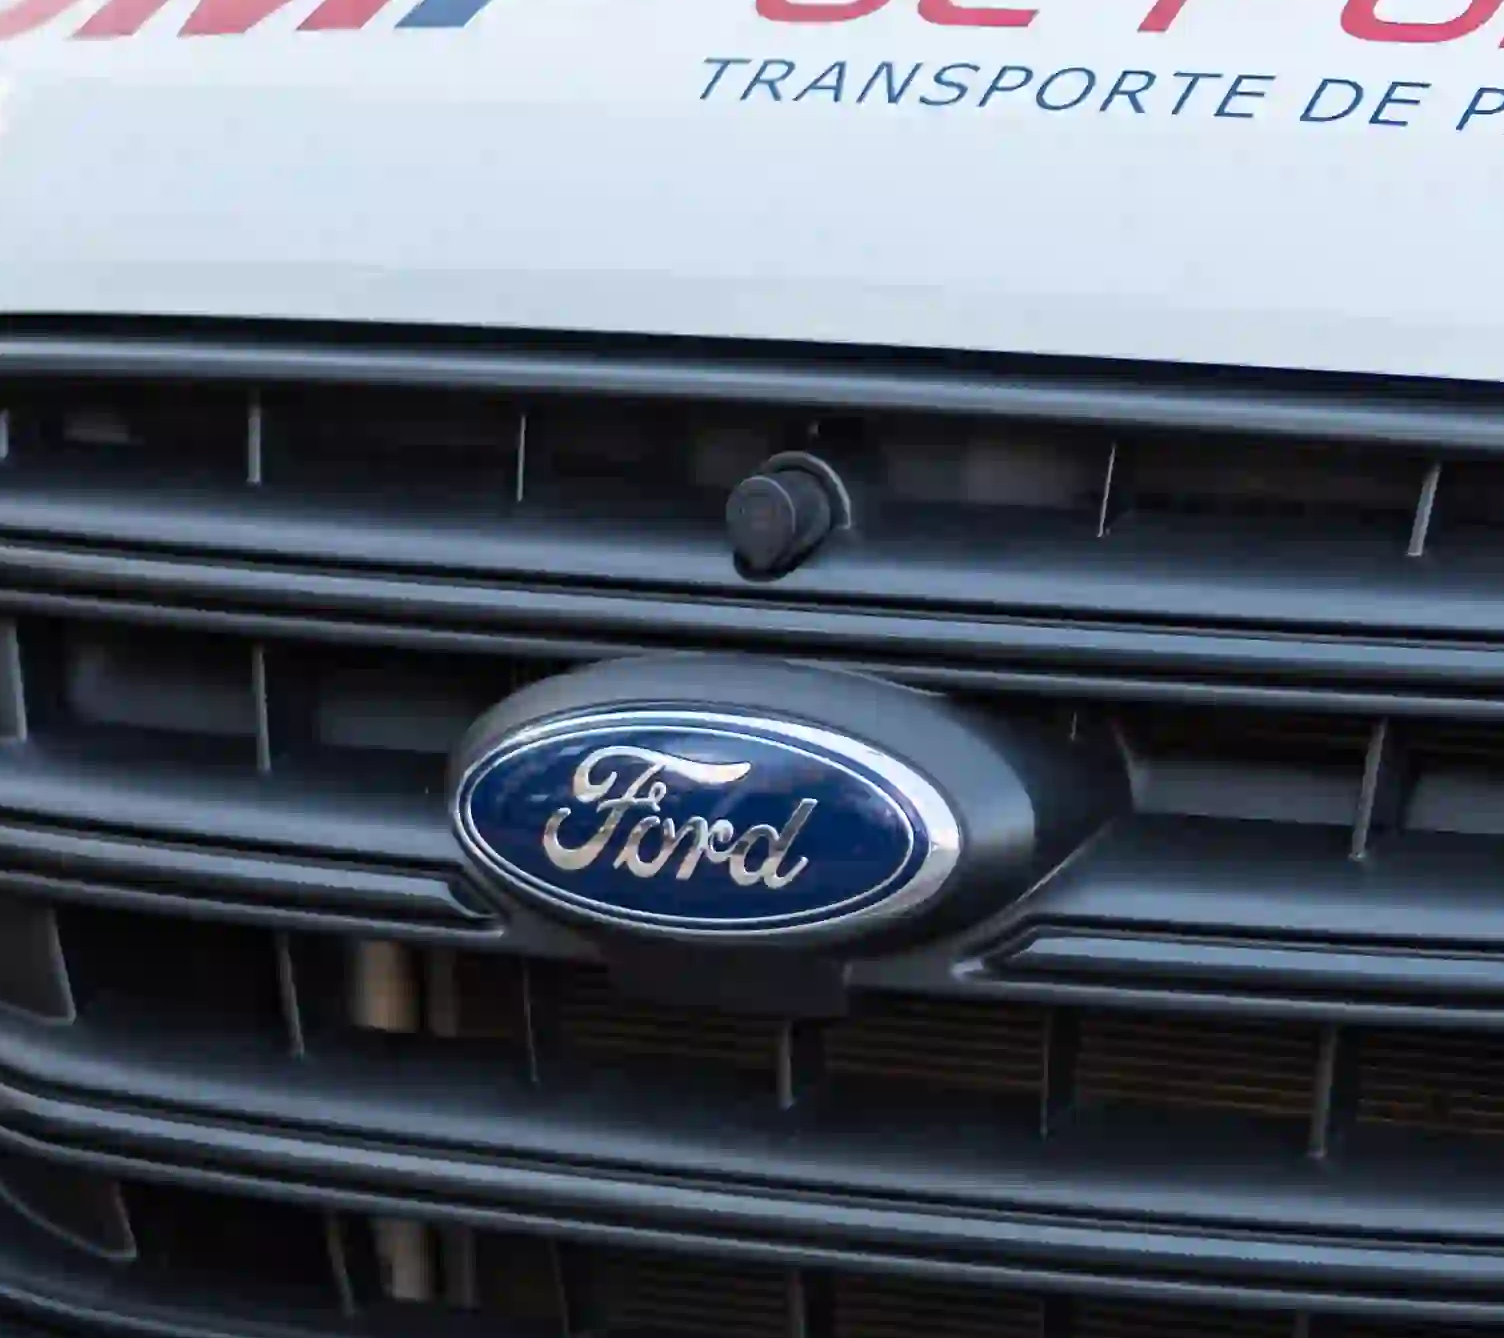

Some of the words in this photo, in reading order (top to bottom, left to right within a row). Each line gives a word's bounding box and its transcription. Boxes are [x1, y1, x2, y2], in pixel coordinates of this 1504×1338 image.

[698, 56, 1277, 119] TRANSPORTE
[1298, 77, 1432, 128] DE
[542, 744, 818, 890] Ford
